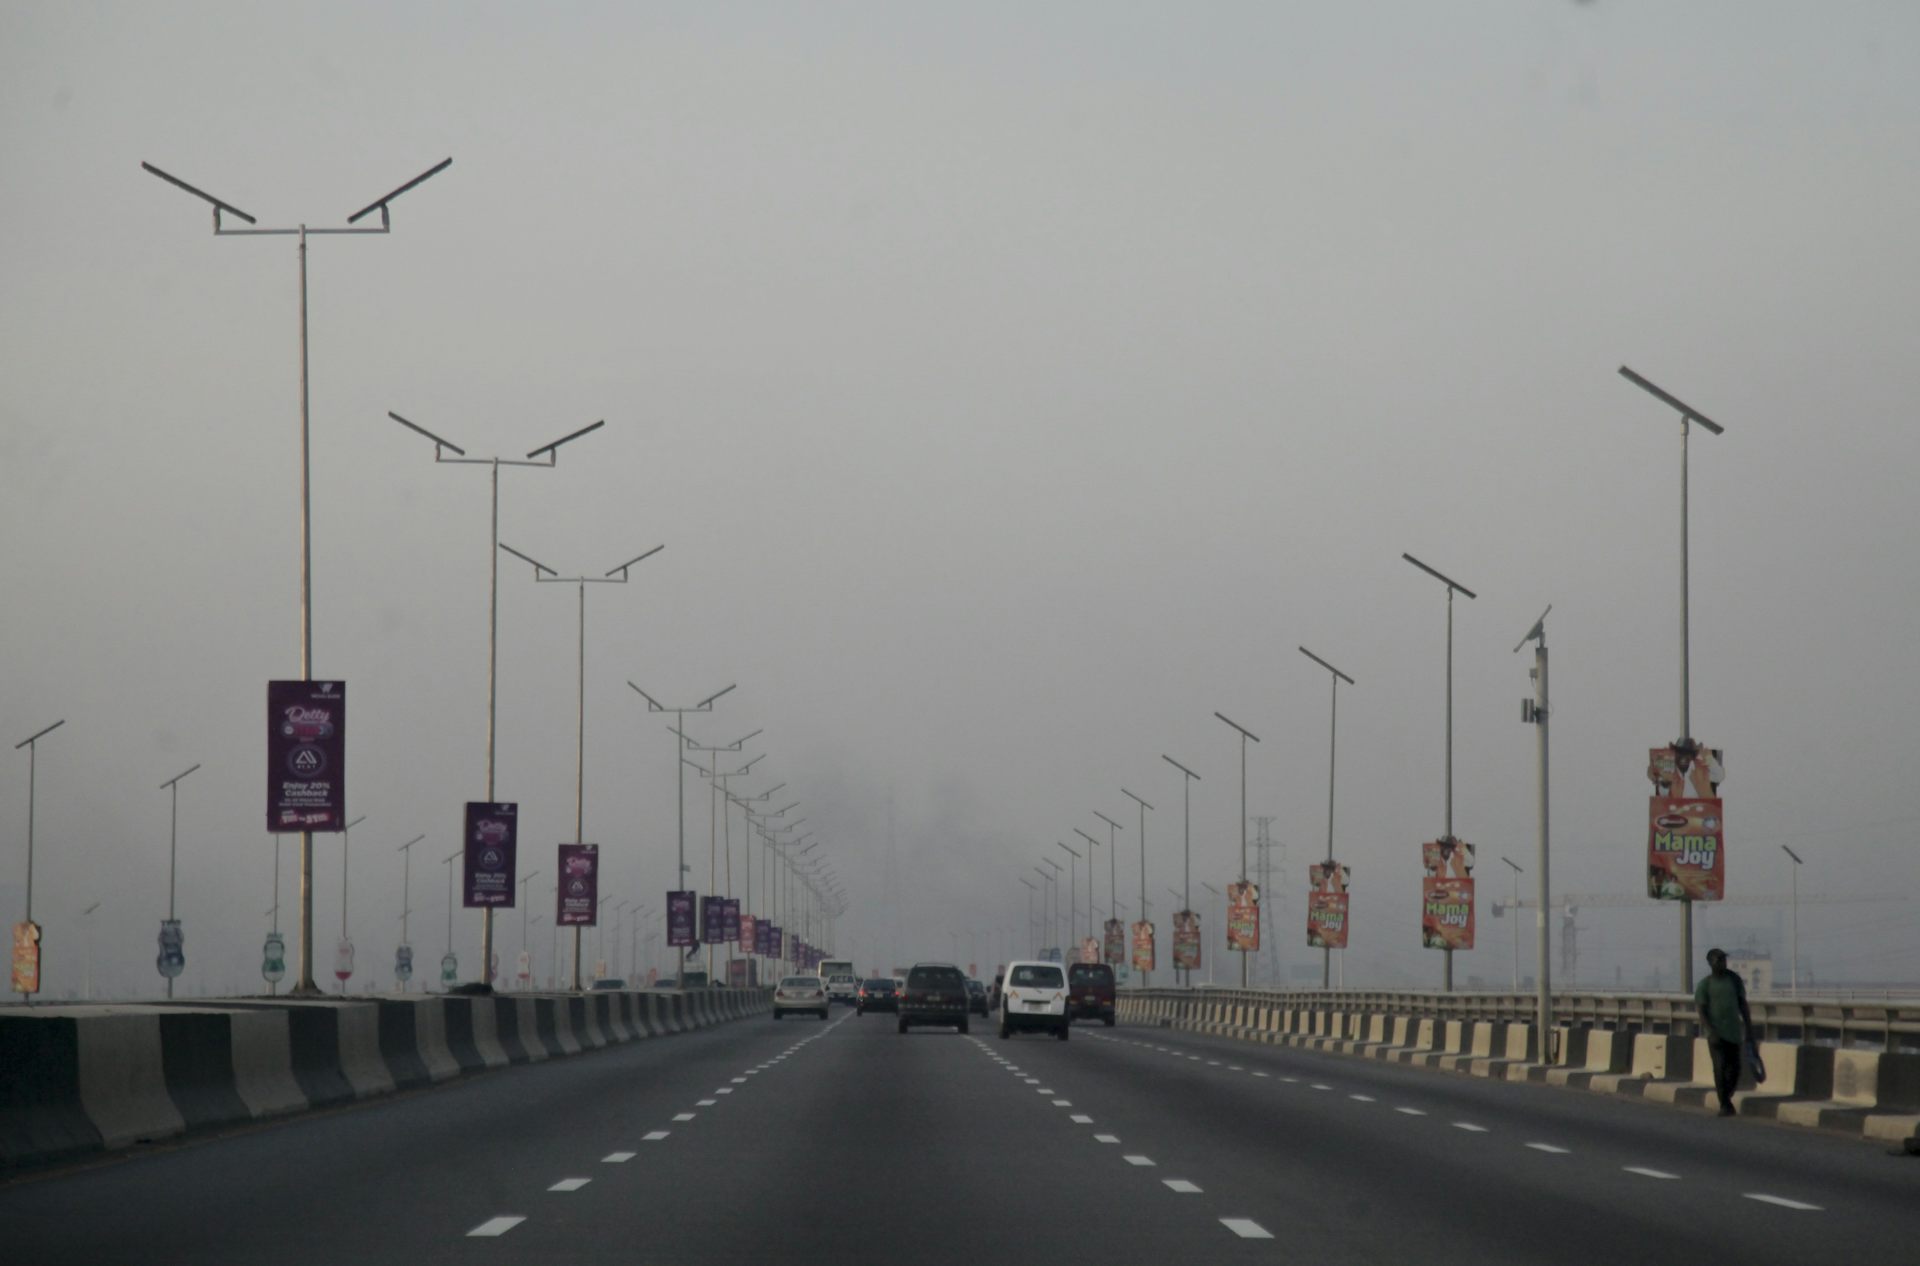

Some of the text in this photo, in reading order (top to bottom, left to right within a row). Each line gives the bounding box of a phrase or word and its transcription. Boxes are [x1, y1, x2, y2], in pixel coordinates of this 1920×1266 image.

[284, 705, 330, 724] Detty
[1654, 831, 1717, 851] Mama
[1675, 848, 1715, 870] Joy
[1426, 902, 1469, 916] Mama
[1440, 912, 1468, 928] Joy
